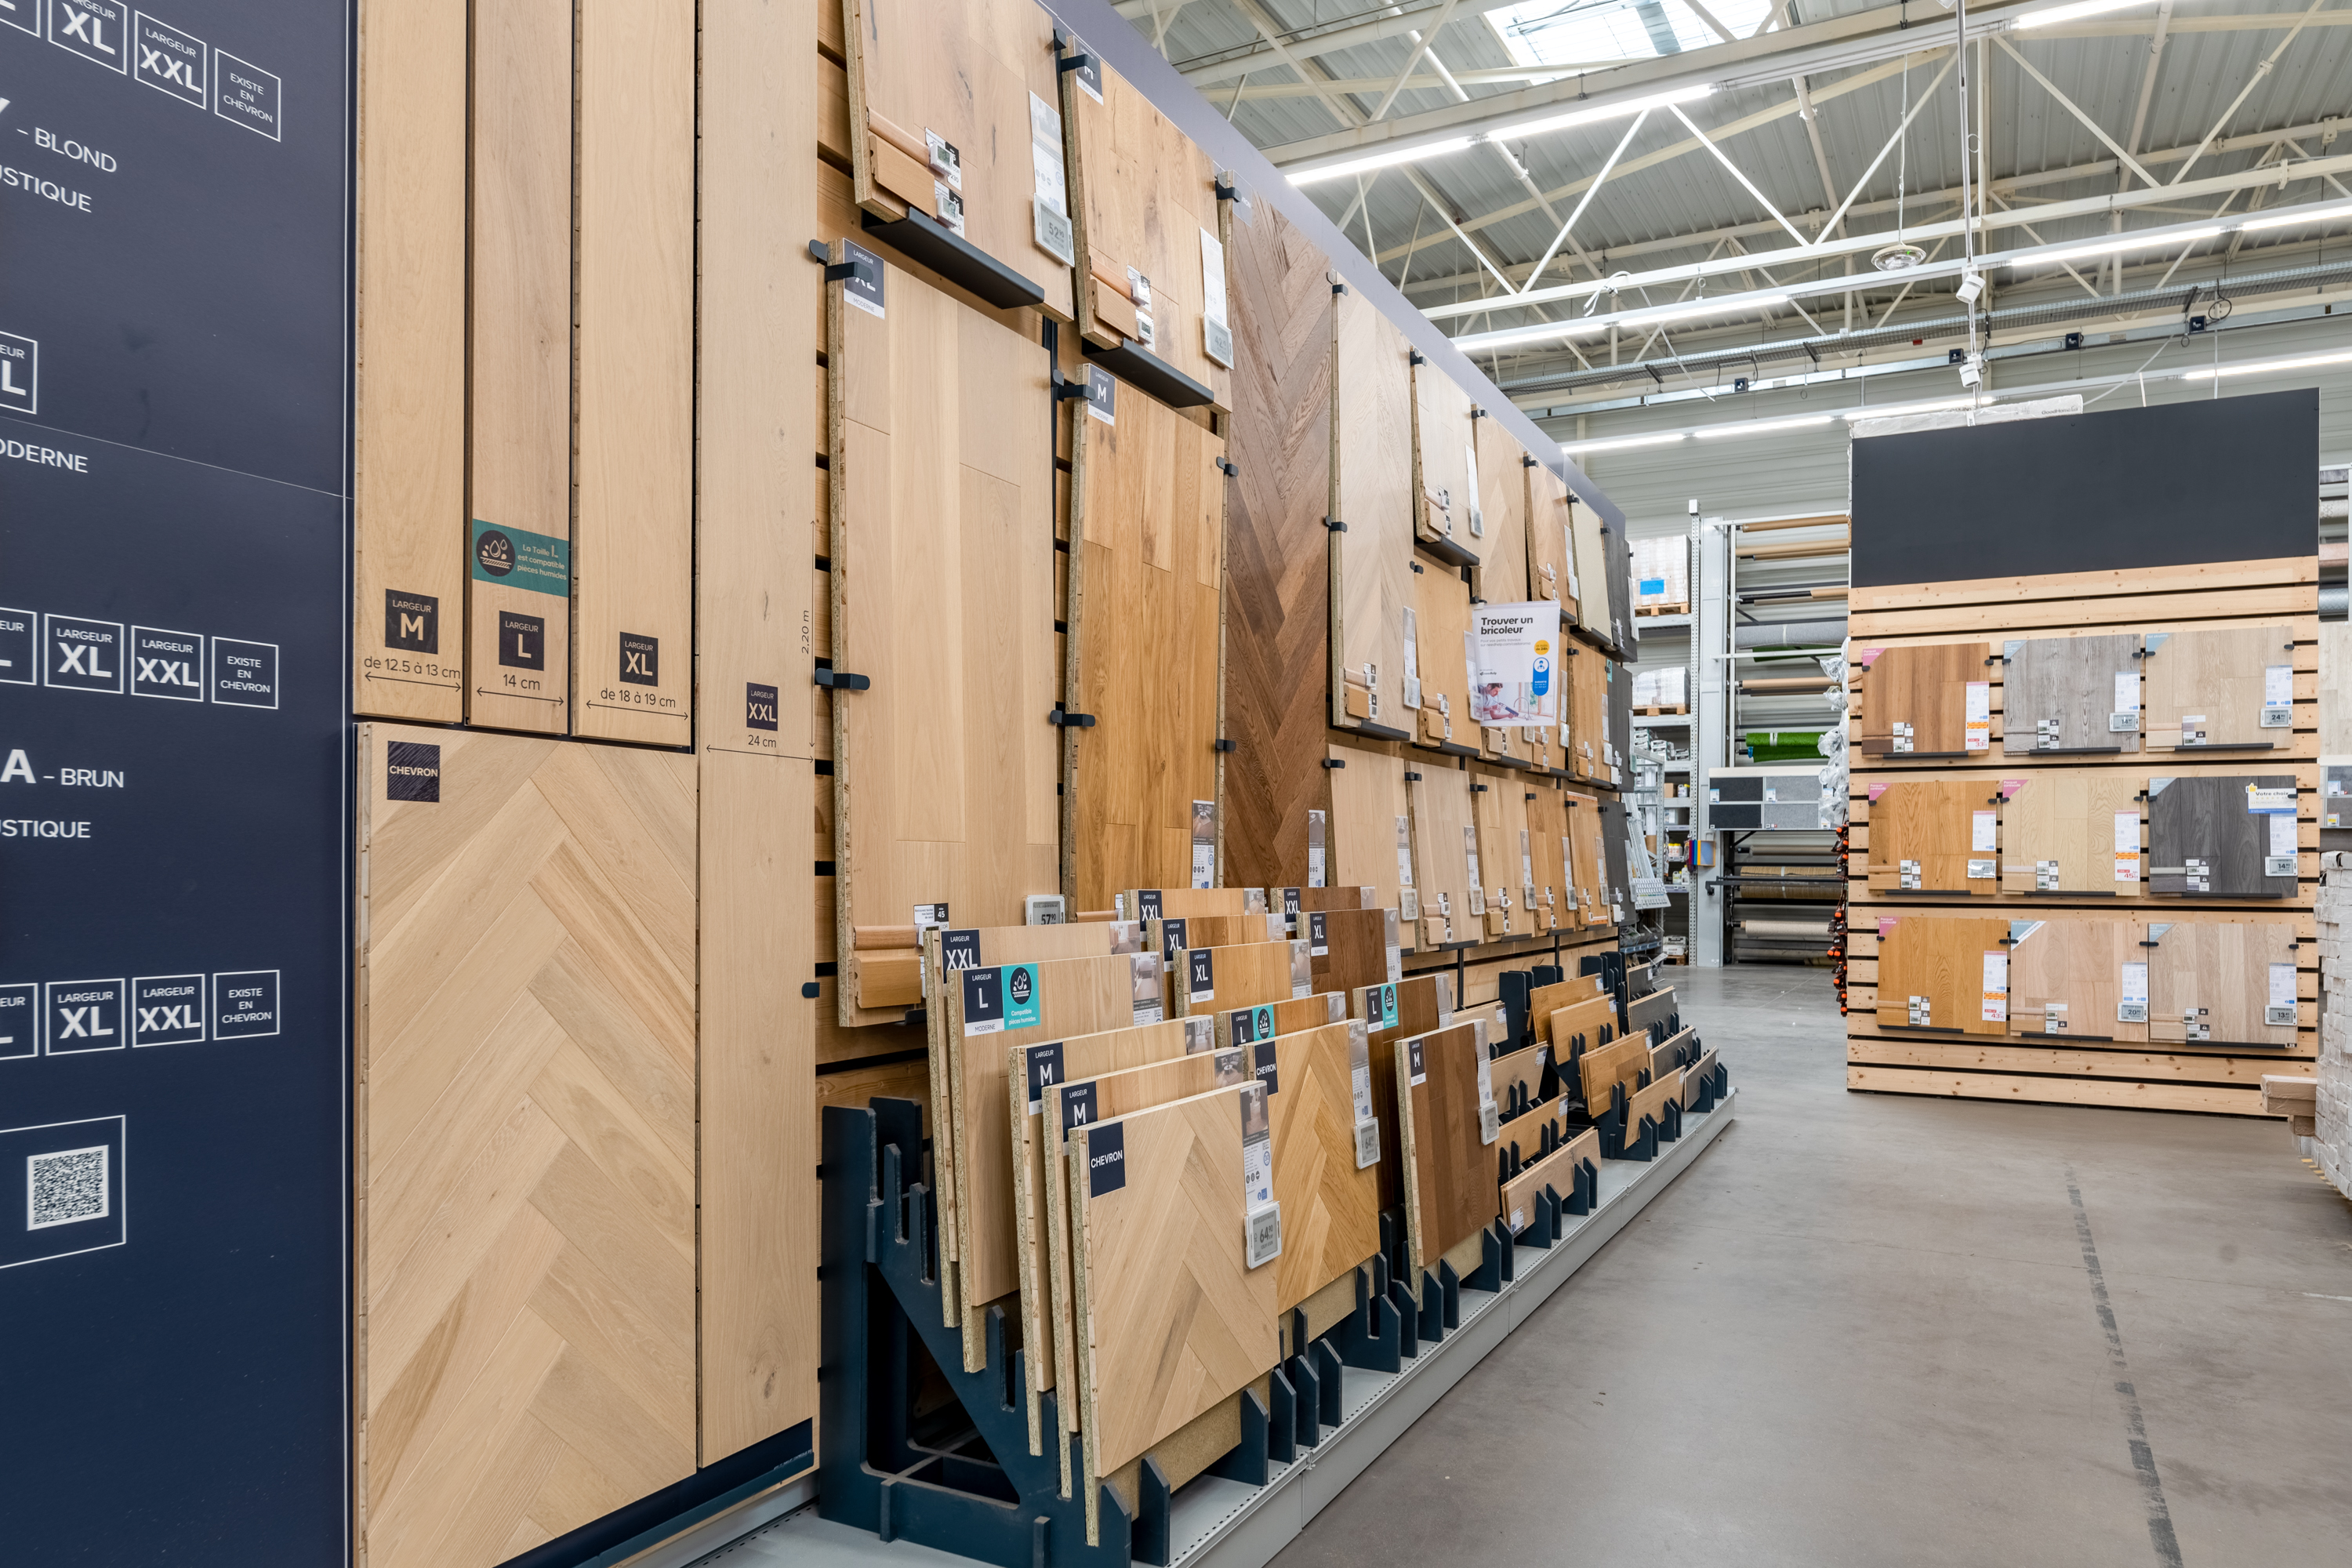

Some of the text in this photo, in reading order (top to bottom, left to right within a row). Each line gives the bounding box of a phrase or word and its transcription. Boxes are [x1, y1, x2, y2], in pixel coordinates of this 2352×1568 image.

[61, 2, 116, 56] XL
[145, 27, 196, 59] LARGEUR
[140, 42, 203, 93] XXL
[230, 72, 264, 96] EXISTE
[240, 89, 255, 103] EN
[223, 94, 273, 124] CHEVRON
[34, 127, 118, 173] BLOND
[0, 164, 93, 213] STIQUE
[853, 249, 874, 265] LARGEUR
[853, 298, 875, 313] MODERNE
[1095, 372, 1109, 383] LARGEUR
[1098, 383, 1106, 403] M
[522, 543, 559, 558] La Taille L
[528, 557, 565, 570] compatible
[517, 564, 567, 580] pièces humides
[392, 599, 432, 613] LARGEUR
[803, 610, 810, 623] m
[1481, 617, 1519, 626] Trouver
[400, 612, 424, 641] M
[505, 620, 539, 633] LARGEUR
[1481, 626, 1523, 635] bricoleur
[56, 628, 113, 644] LARGEUR
[142, 639, 194, 655] LARGEUR
[517, 633, 532, 659] L
[624, 641, 653, 652] LARGEUR
[57, 642, 113, 678] XL
[227, 655, 262, 668] EXISTE
[364, 655, 461, 680] de 12.5 à 13 cm
[626, 651, 653, 676] XL
[136, 656, 200, 688] XXL
[237, 669, 252, 680] EN
[220, 680, 271, 694] CHEVRON
[503, 673, 541, 691] 14 cm
[601, 688, 676, 708] de 18 à 19 cm
[750, 690, 774, 699] LARGEUR
[748, 702, 777, 722] XXL
[748, 735, 777, 748] 24 cm
[0, 749, 37, 784] A
[60, 768, 125, 788] BRUN
[389, 765, 438, 778] CHEVRON
[0, 819, 92, 839] STIQUE
[1141, 905, 1161, 921] XXL
[1286, 900, 1300, 914] XXL
[1314, 925, 1324, 939] XL
[1169, 934, 1182, 951] XL
[946, 948, 978, 971] XXL
[1196, 964, 1208, 982] XL
[57, 990, 114, 1004] LARGEUR
[143, 985, 195, 999] LARGEUR
[228, 987, 263, 999] EXISTE
[978, 988, 988, 1008] L
[238, 1000, 253, 1011] EN
[1372, 1000, 1377, 1014] L
[59, 1006, 114, 1040] XL
[137, 1004, 201, 1033] XXL
[221, 1010, 273, 1025] CHEVRON
[1240, 1026, 1246, 1044] L
[1035, 1050, 1054, 1058] LARGEUR
[1414, 1052, 1421, 1067] M
[1040, 1063, 1052, 1086] M
[1256, 1062, 1276, 1076] CHEVRON
[1069, 1088, 1087, 1098] LARGEUR
[1073, 1102, 1087, 1127] M
[1091, 1149, 1123, 1168] CHEVRON
